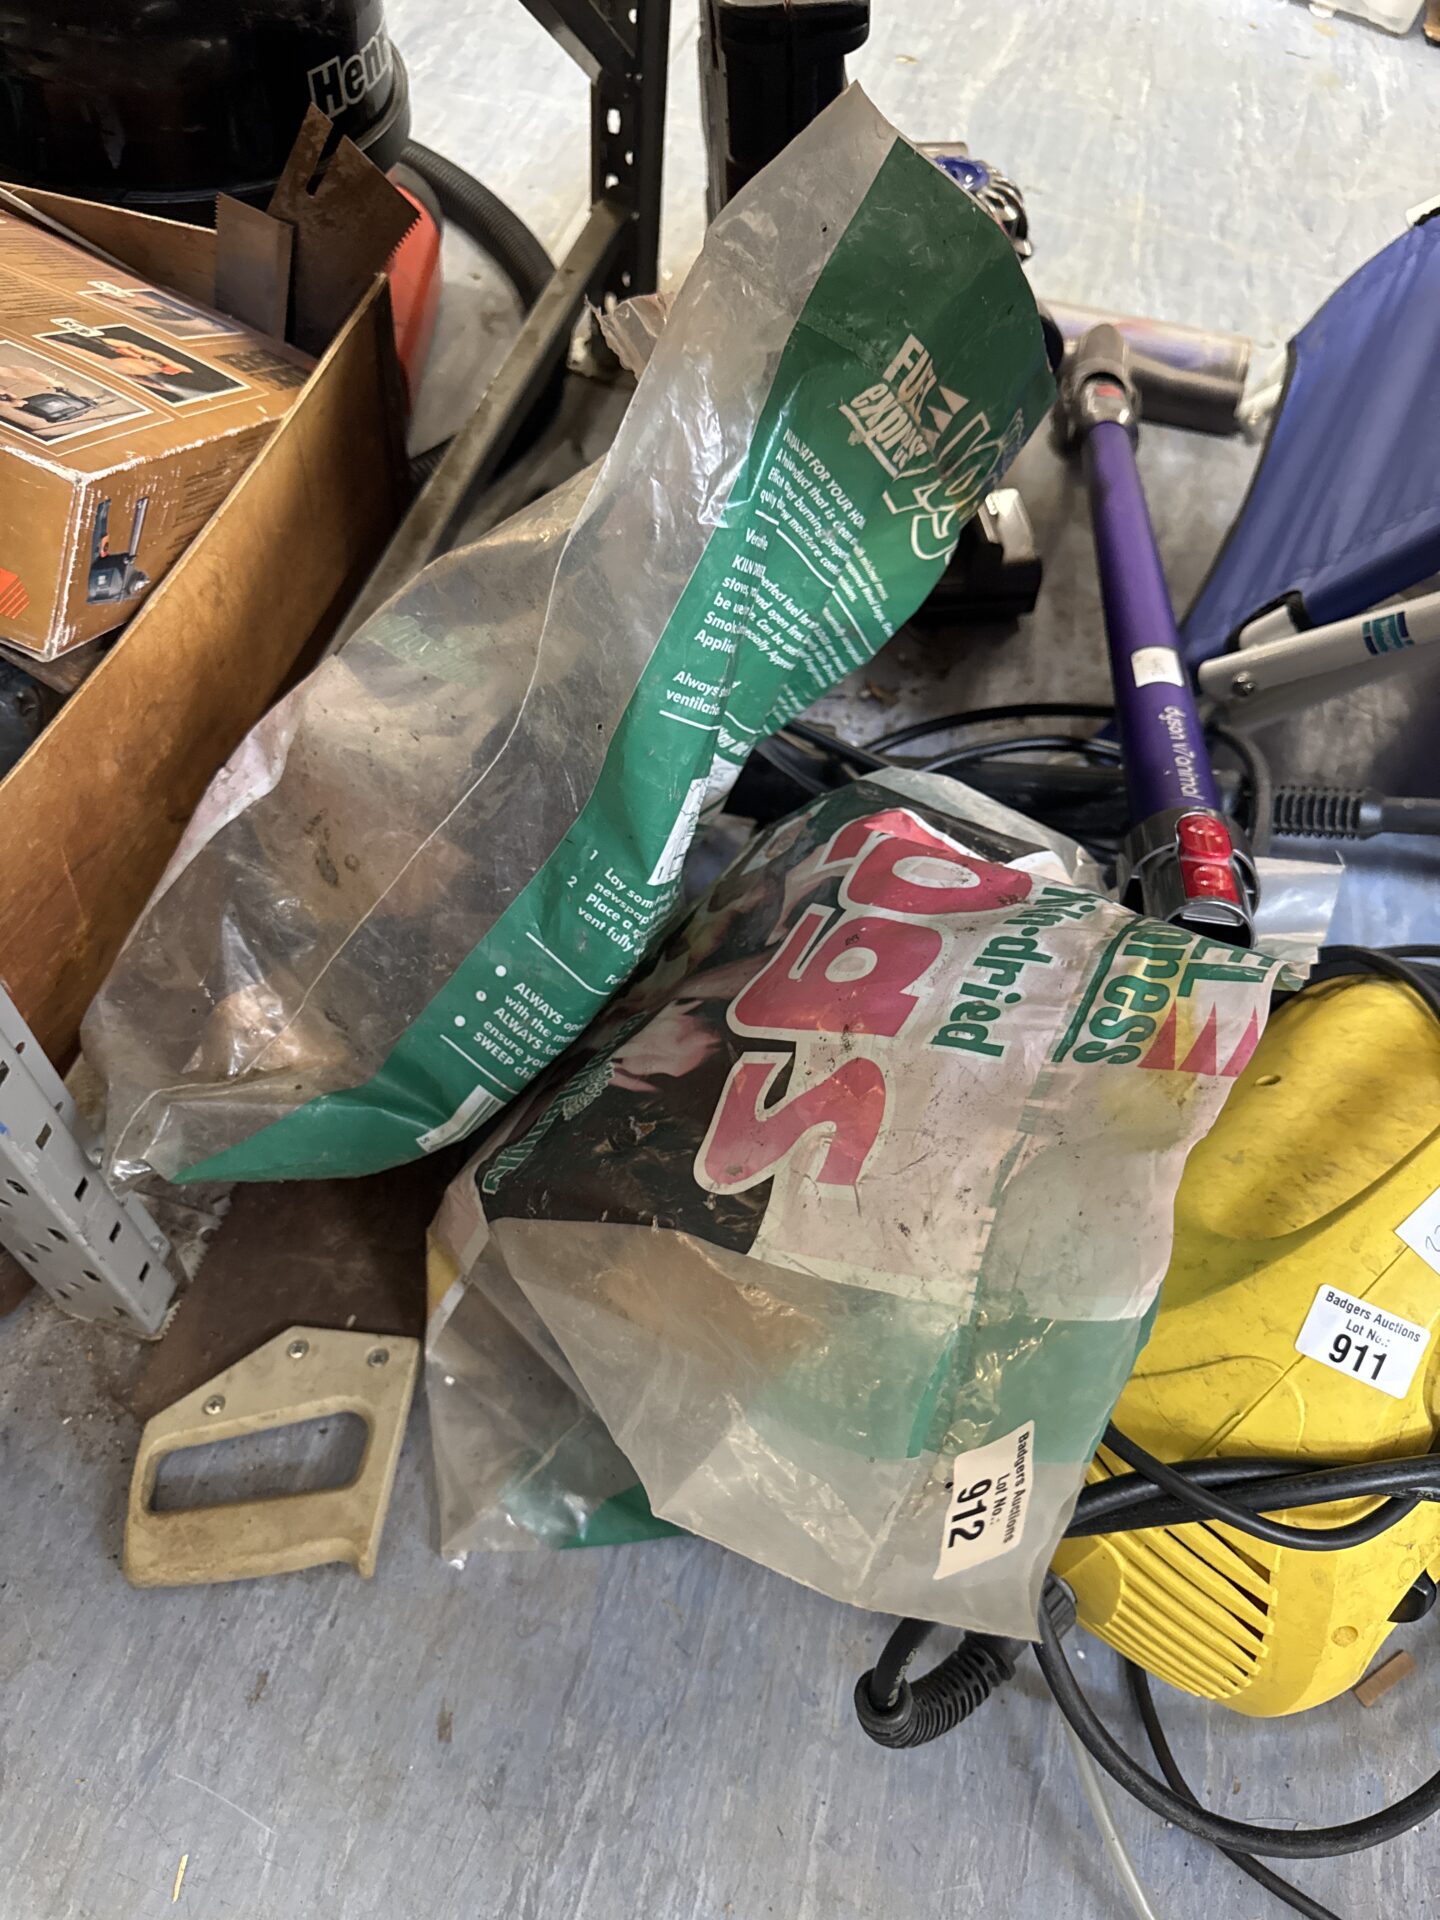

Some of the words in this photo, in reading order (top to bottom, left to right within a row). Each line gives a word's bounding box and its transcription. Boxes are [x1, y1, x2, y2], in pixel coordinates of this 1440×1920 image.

[808, 485, 829, 509] that
[824, 507, 836, 520] is
[809, 458, 831, 482] FOR
[826, 480, 853, 513] YOUR
[788, 517, 822, 557] moisture
[713, 591, 732, 610] be
[756, 618, 774, 635] Can
[770, 632, 785, 646] be
[767, 609, 790, 629] open
[782, 597, 805, 618] fuel
[673, 670, 719, 697] Always
[1158, 706, 1186, 739] dyson
[566, 875, 578, 888] 2
[585, 892, 621, 921] Place
[622, 919, 633, 930] a
[594, 881, 650, 926] newspap
[604, 867, 627, 890] Lay
[626, 889, 655, 909] som
[577, 906, 606, 931] vent
[605, 926, 635, 952] fully
[505, 995, 530, 1020] with
[530, 1016, 552, 1038] the
[513, 981, 564, 1025] ALWAYS
[472, 1030, 515, 1066] SWEEP
[483, 1021, 524, 1057] ensure
[493, 1006, 543, 1051] ALWAYS
[1325, 1290, 1372, 1320] Badgers
[1373, 1313, 1421, 1343] Auctions
[1345, 1319, 1365, 1337] Lot
[1328, 1333, 1388, 1381] 911
[1013, 1431, 1030, 1488] Badgers
[994, 1472, 1011, 1496] Lot
[947, 1478, 993, 1549] 912
[1003, 1488, 1026, 1544] Auctions
